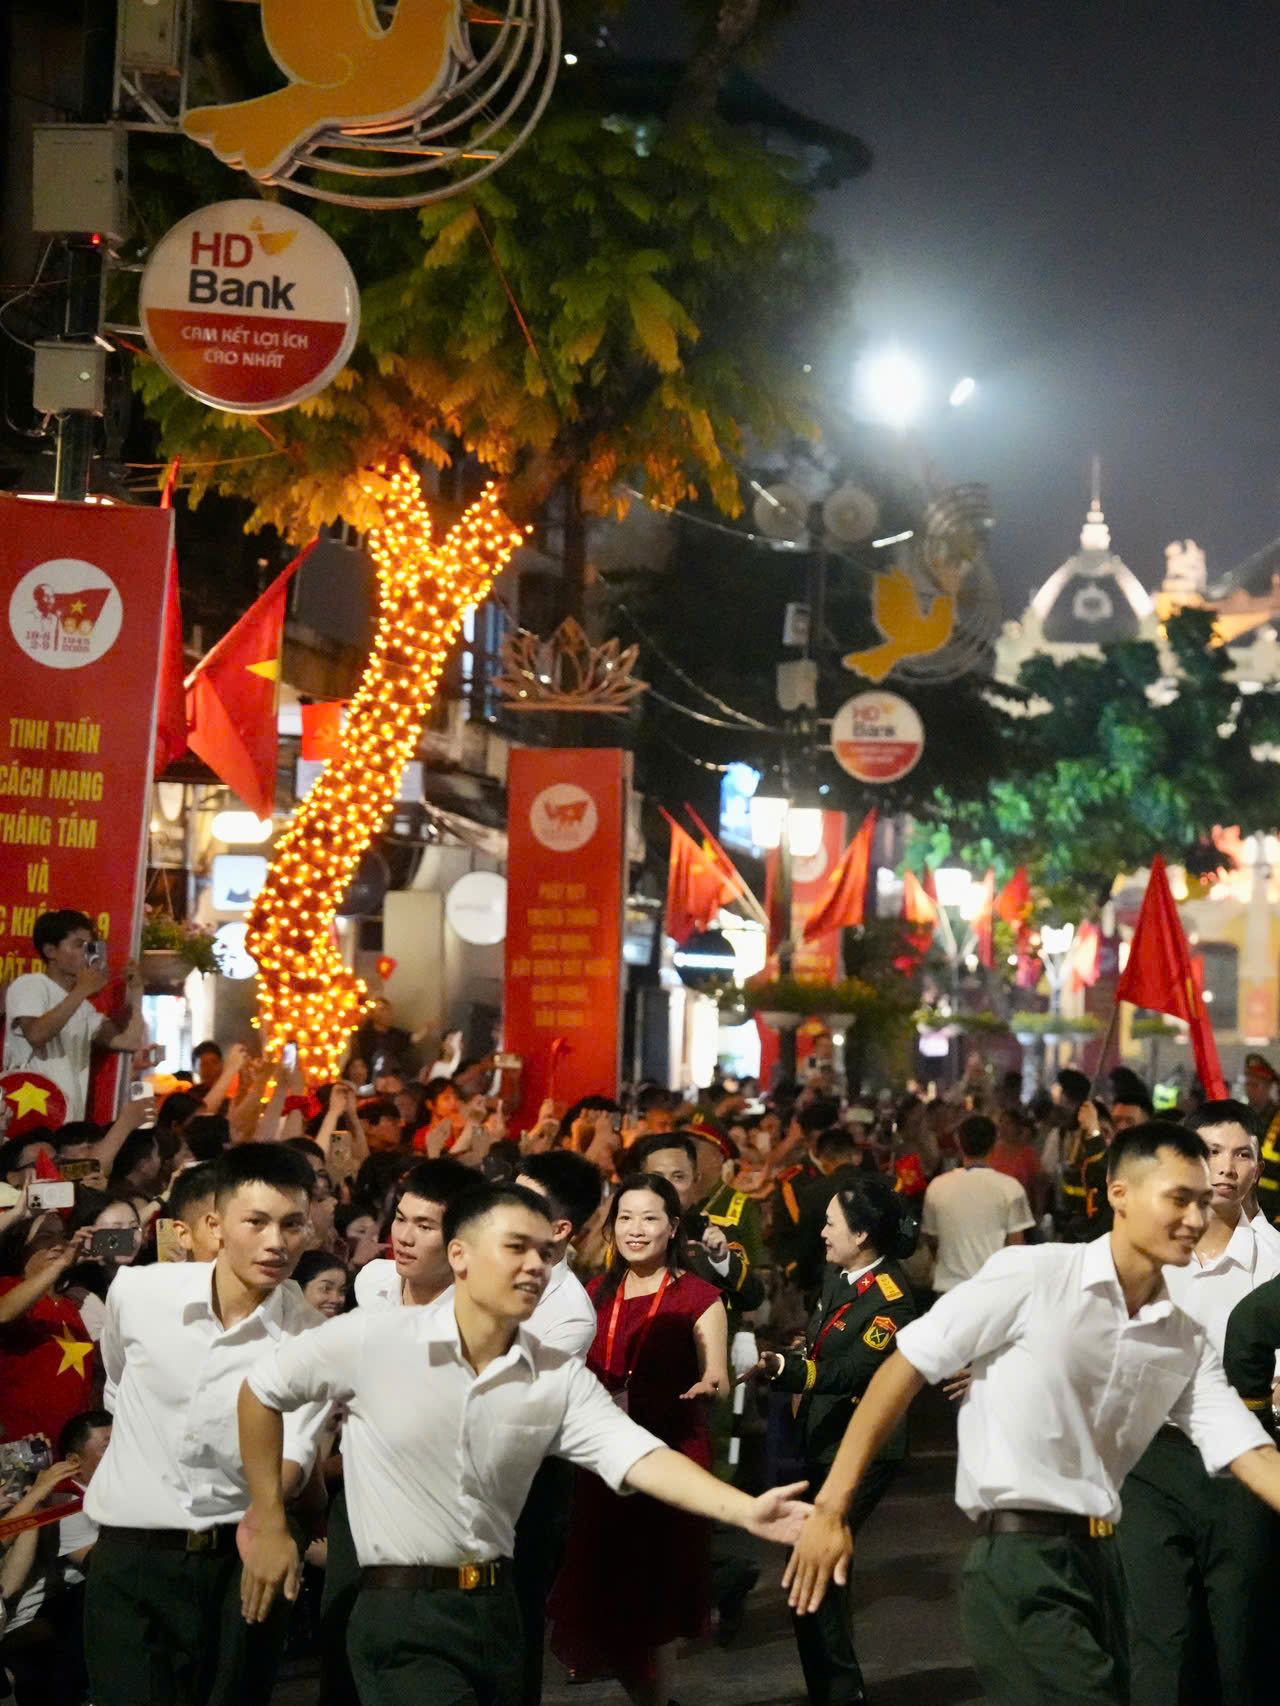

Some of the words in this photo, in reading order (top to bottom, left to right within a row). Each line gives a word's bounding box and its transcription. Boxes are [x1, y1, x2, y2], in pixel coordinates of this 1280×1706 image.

[190, 231, 254, 268] HD
[188, 269, 296, 311] Bank
[181, 325, 217, 342] CAM
[204, 349, 238, 365] CAO
[10, 718, 49, 750] TINH
[55, 716, 101, 753] THẦN
[49, 769, 104, 806] MẠNG
[58, 812, 98, 849] TÁM
[27, 857, 49, 893] VÀ
